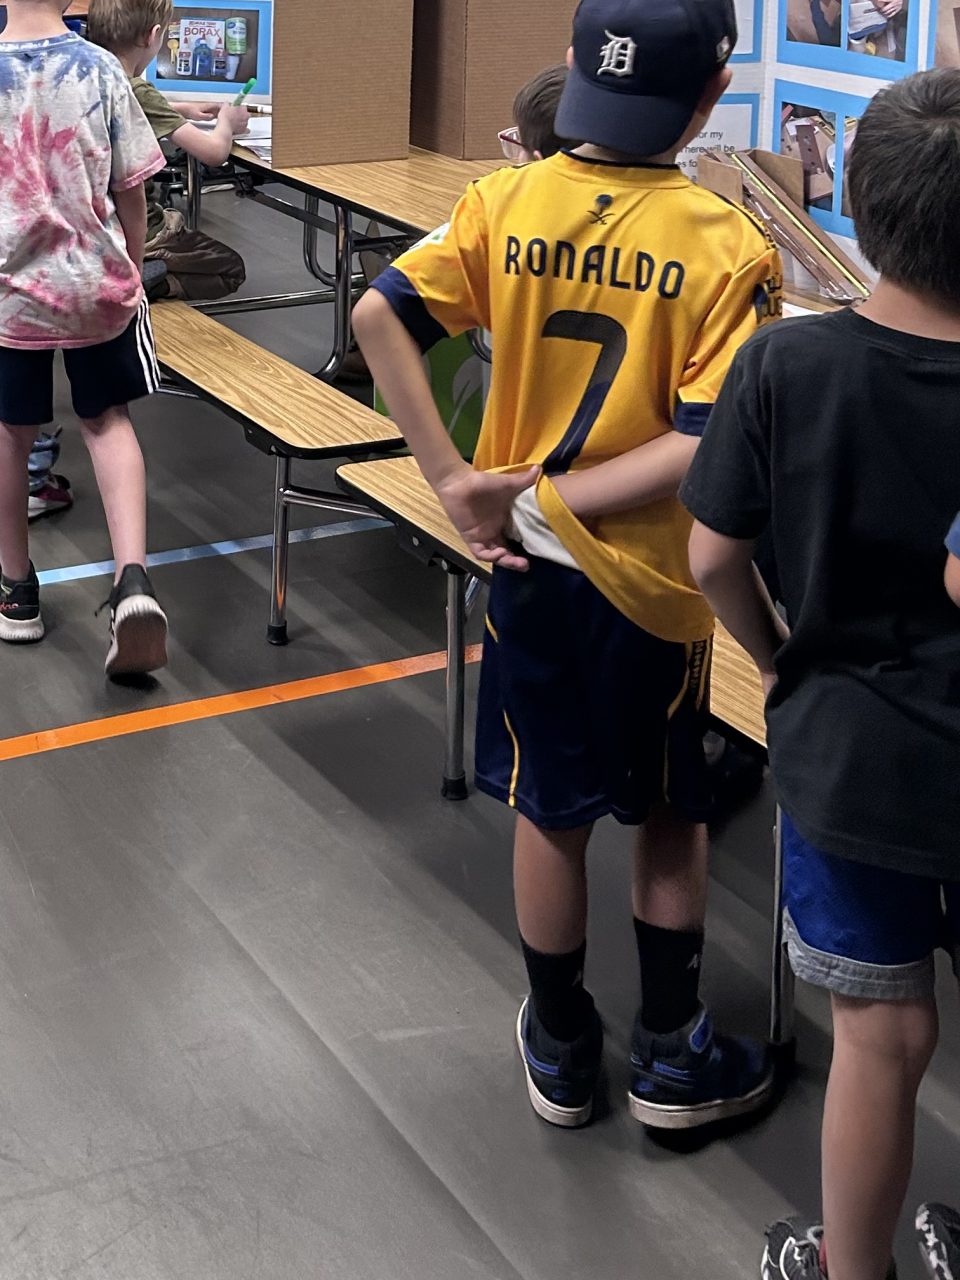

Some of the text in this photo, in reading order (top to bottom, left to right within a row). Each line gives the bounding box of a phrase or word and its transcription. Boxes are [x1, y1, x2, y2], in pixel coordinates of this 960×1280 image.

[184, 27, 221, 37] BORAX
[596, 29, 638, 77] D
[710, 131, 724, 140] my
[723, 145, 735, 153] be
[504, 235, 686, 300] RONALDO
[541, 309, 628, 478] 7
